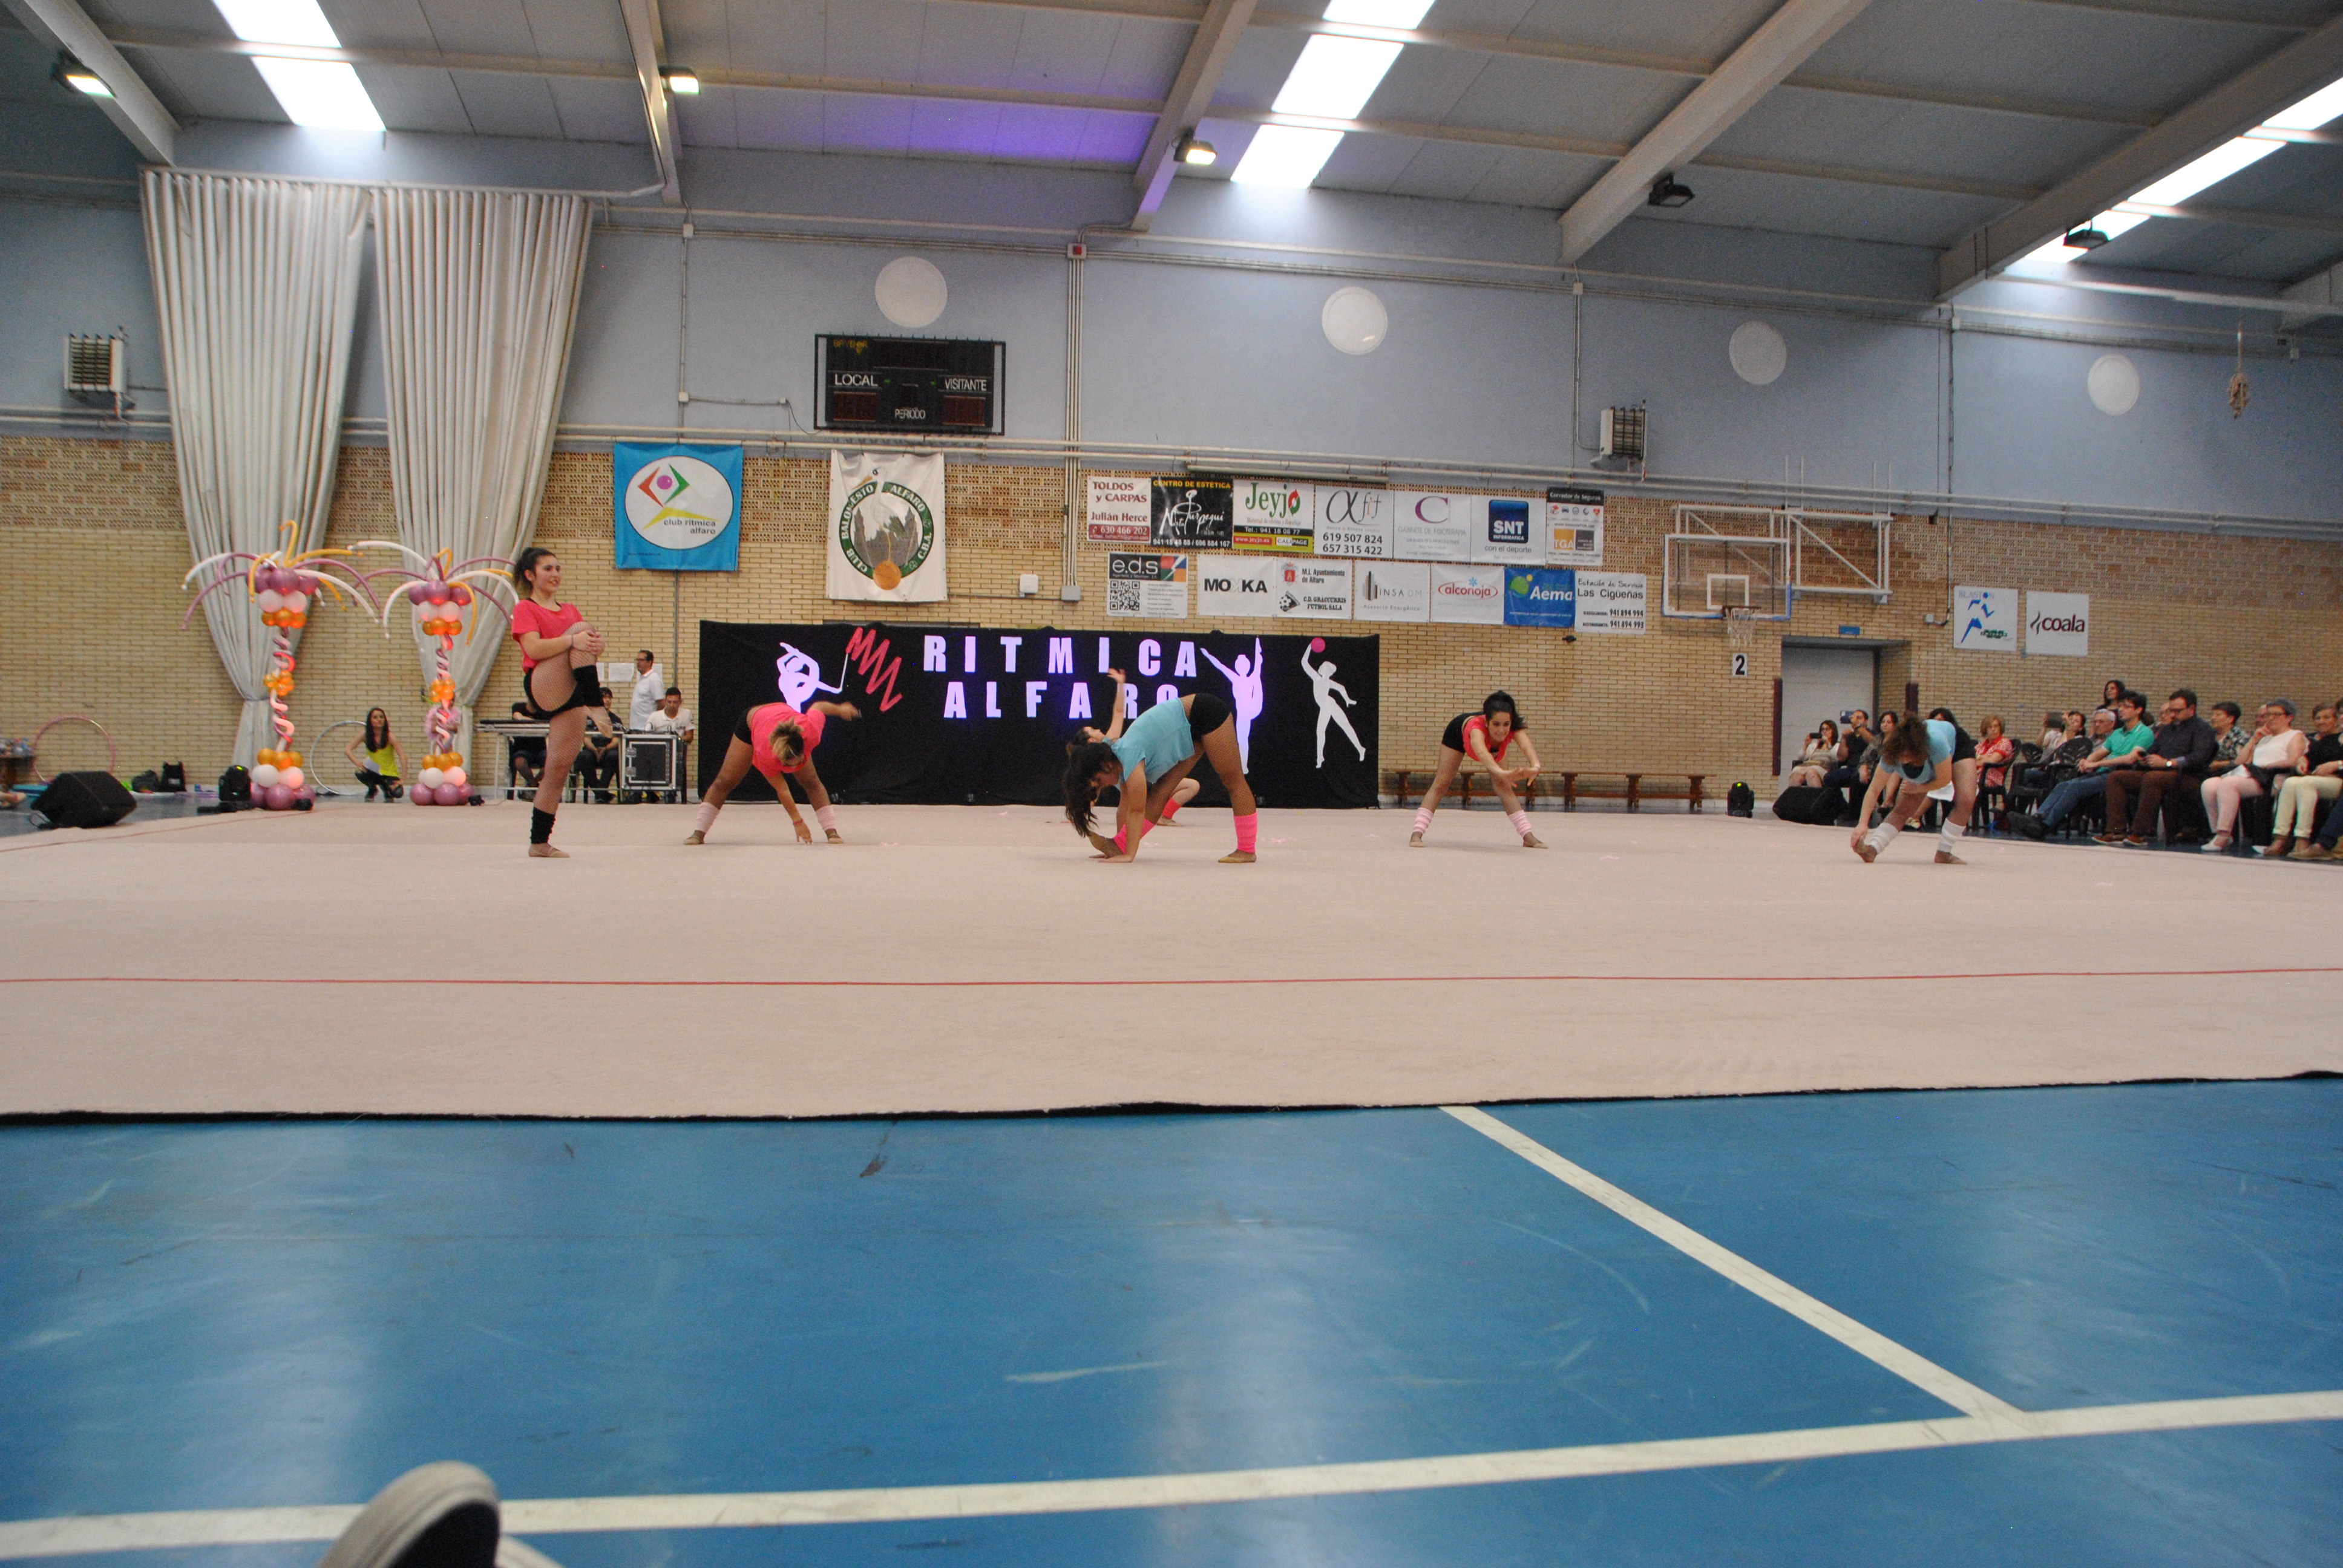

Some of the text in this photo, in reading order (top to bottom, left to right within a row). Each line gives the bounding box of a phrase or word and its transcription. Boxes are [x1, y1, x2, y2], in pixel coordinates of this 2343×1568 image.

[834, 373, 877, 387] LOCAL
[945, 378, 987, 391] VISITANTE
[894, 408, 926, 420] PERIODO
[1092, 482, 1134, 491] TOLDOS
[890, 485, 926, 512] ALFARO
[1105, 493, 1147, 503] CARPAS
[1091, 512, 1148, 521] Julián Herce
[1493, 520, 1524, 534] SNT
[1323, 532, 1383, 544] 619 507 824
[1554, 539, 1574, 549] TGA
[1322, 543, 1383, 555] 657 315 422
[847, 548, 868, 572] CLUB
[1578, 578, 1605, 587] Estación
[1618, 580, 1643, 589] Servicio
[1379, 588, 1422, 598] INSA DM
[1444, 582, 1491, 599] alcorioja
[1577, 587, 1595, 598] Las
[1610, 608, 1619, 616] 941
[1620, 609, 1632, 617] 894
[2042, 613, 2085, 633] coala
[1735, 654, 1745, 675] 2
